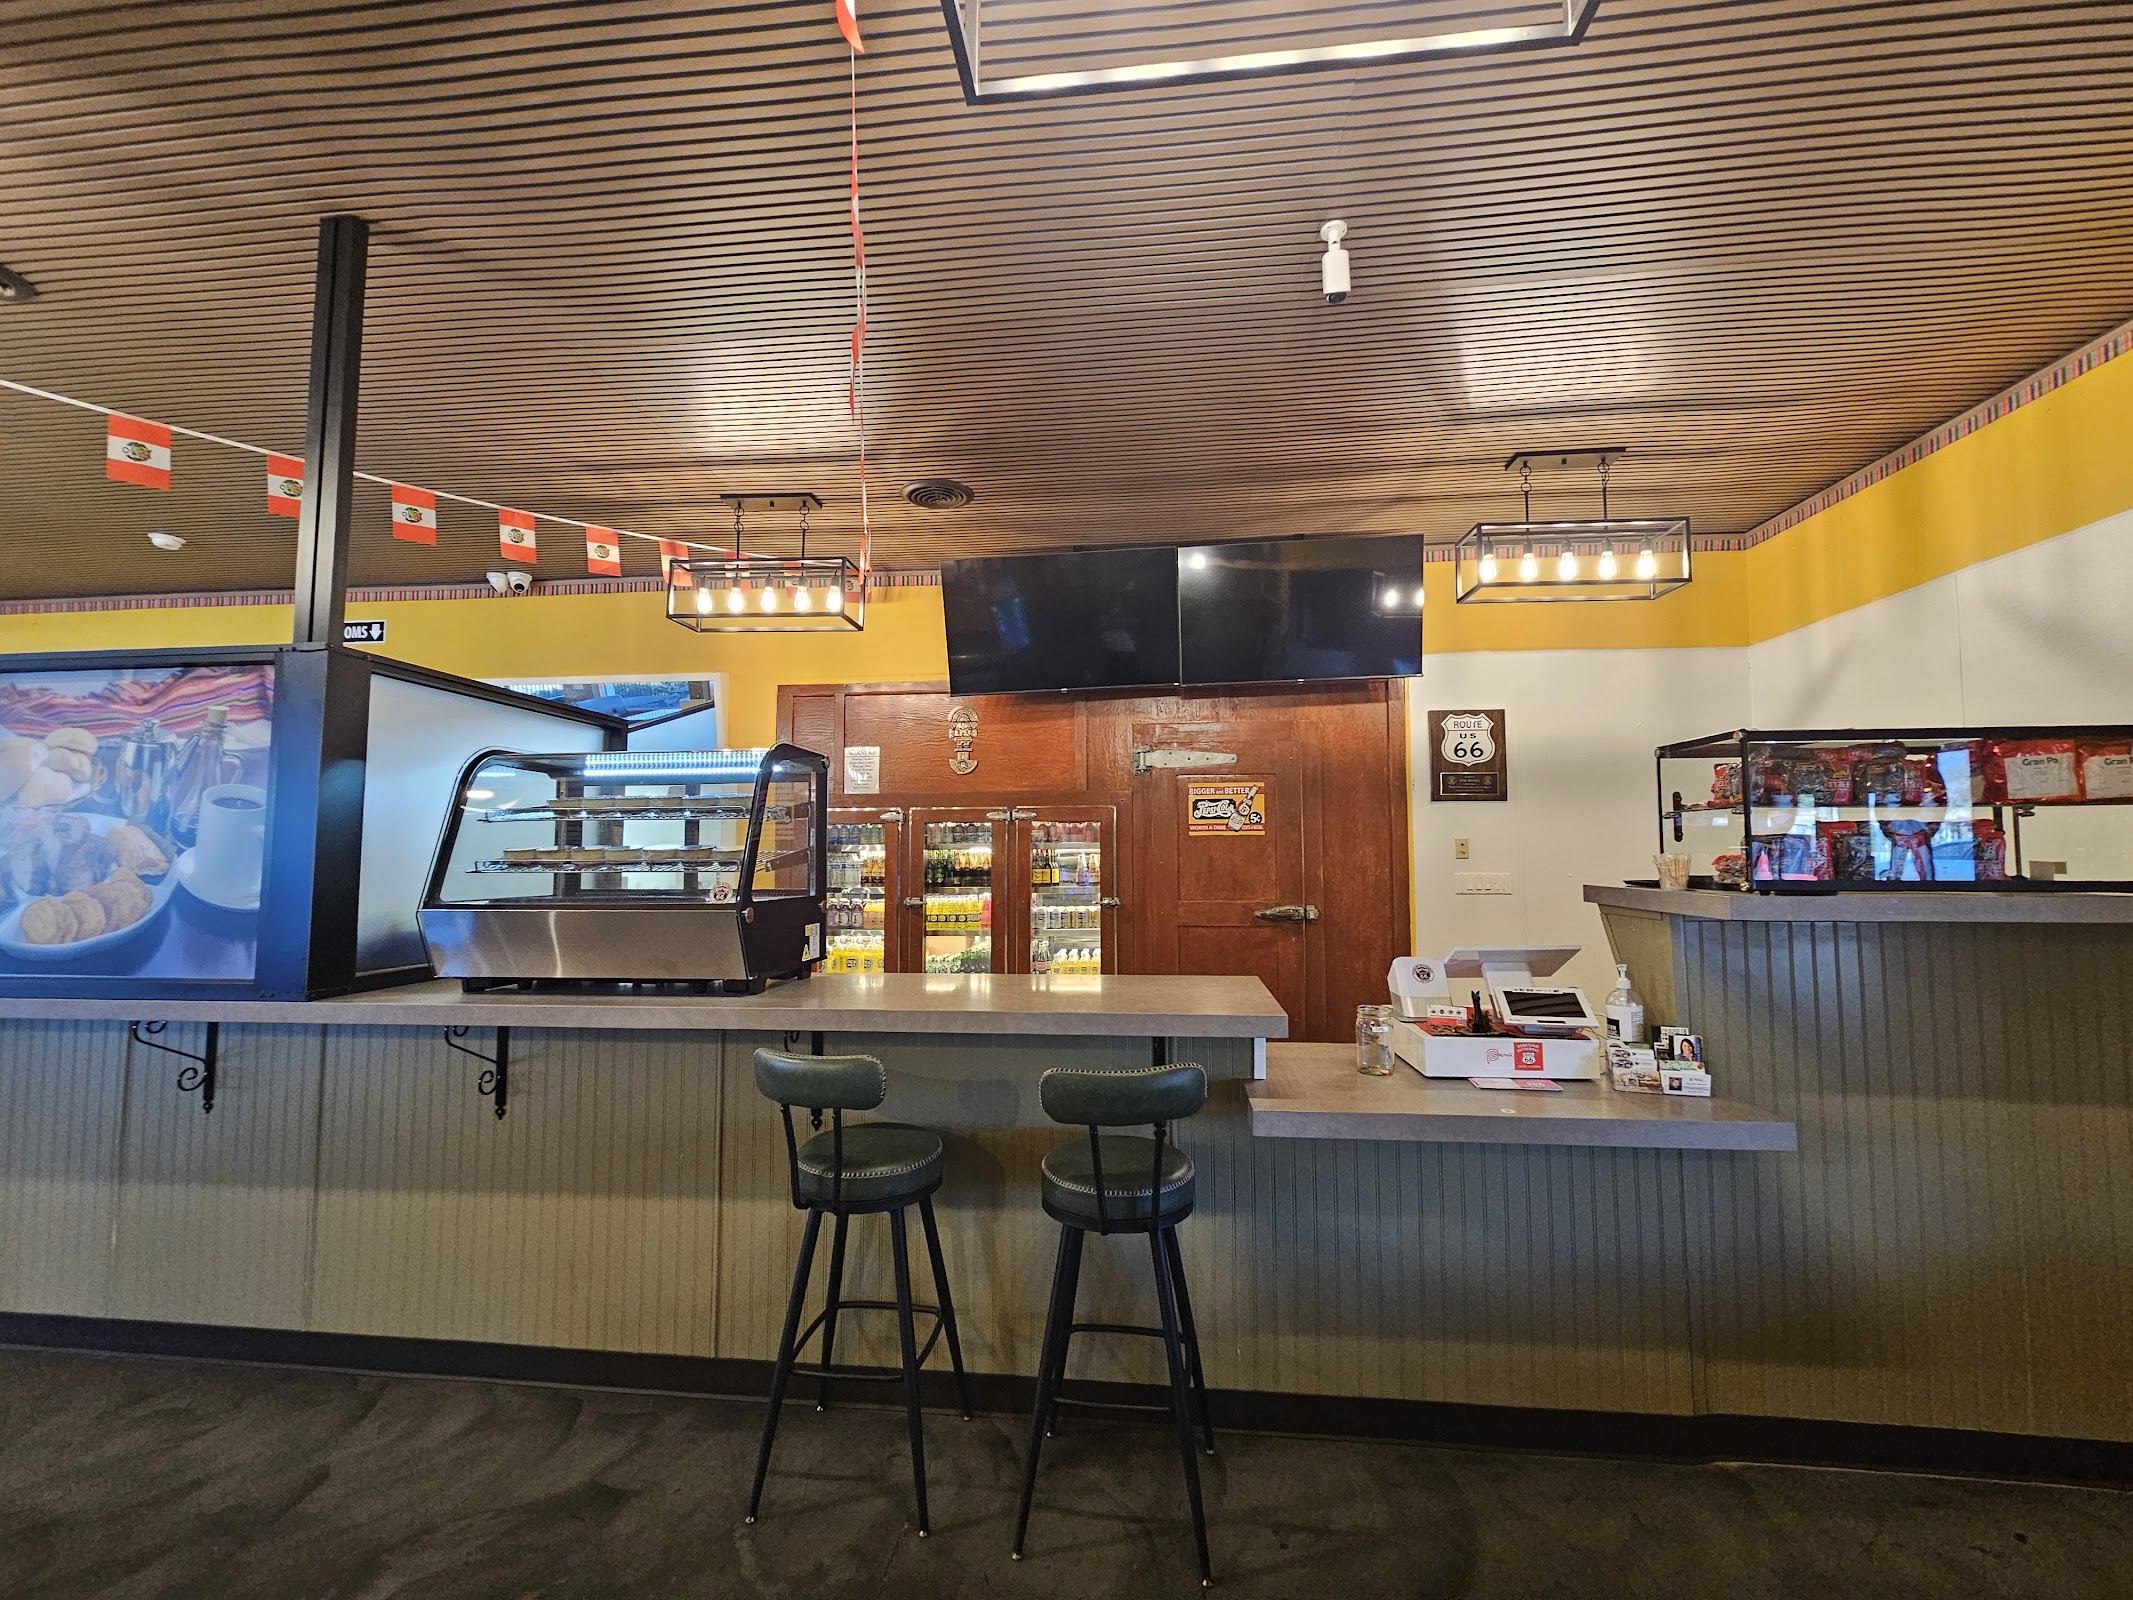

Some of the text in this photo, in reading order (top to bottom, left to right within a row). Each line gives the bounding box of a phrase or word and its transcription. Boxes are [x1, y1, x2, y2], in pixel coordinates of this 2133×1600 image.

[344, 626, 368, 639] OMS
[1453, 720, 1482, 729] ROUTE
[1454, 741, 1483, 758] 66
[1250, 813, 1261, 823] 5¢
